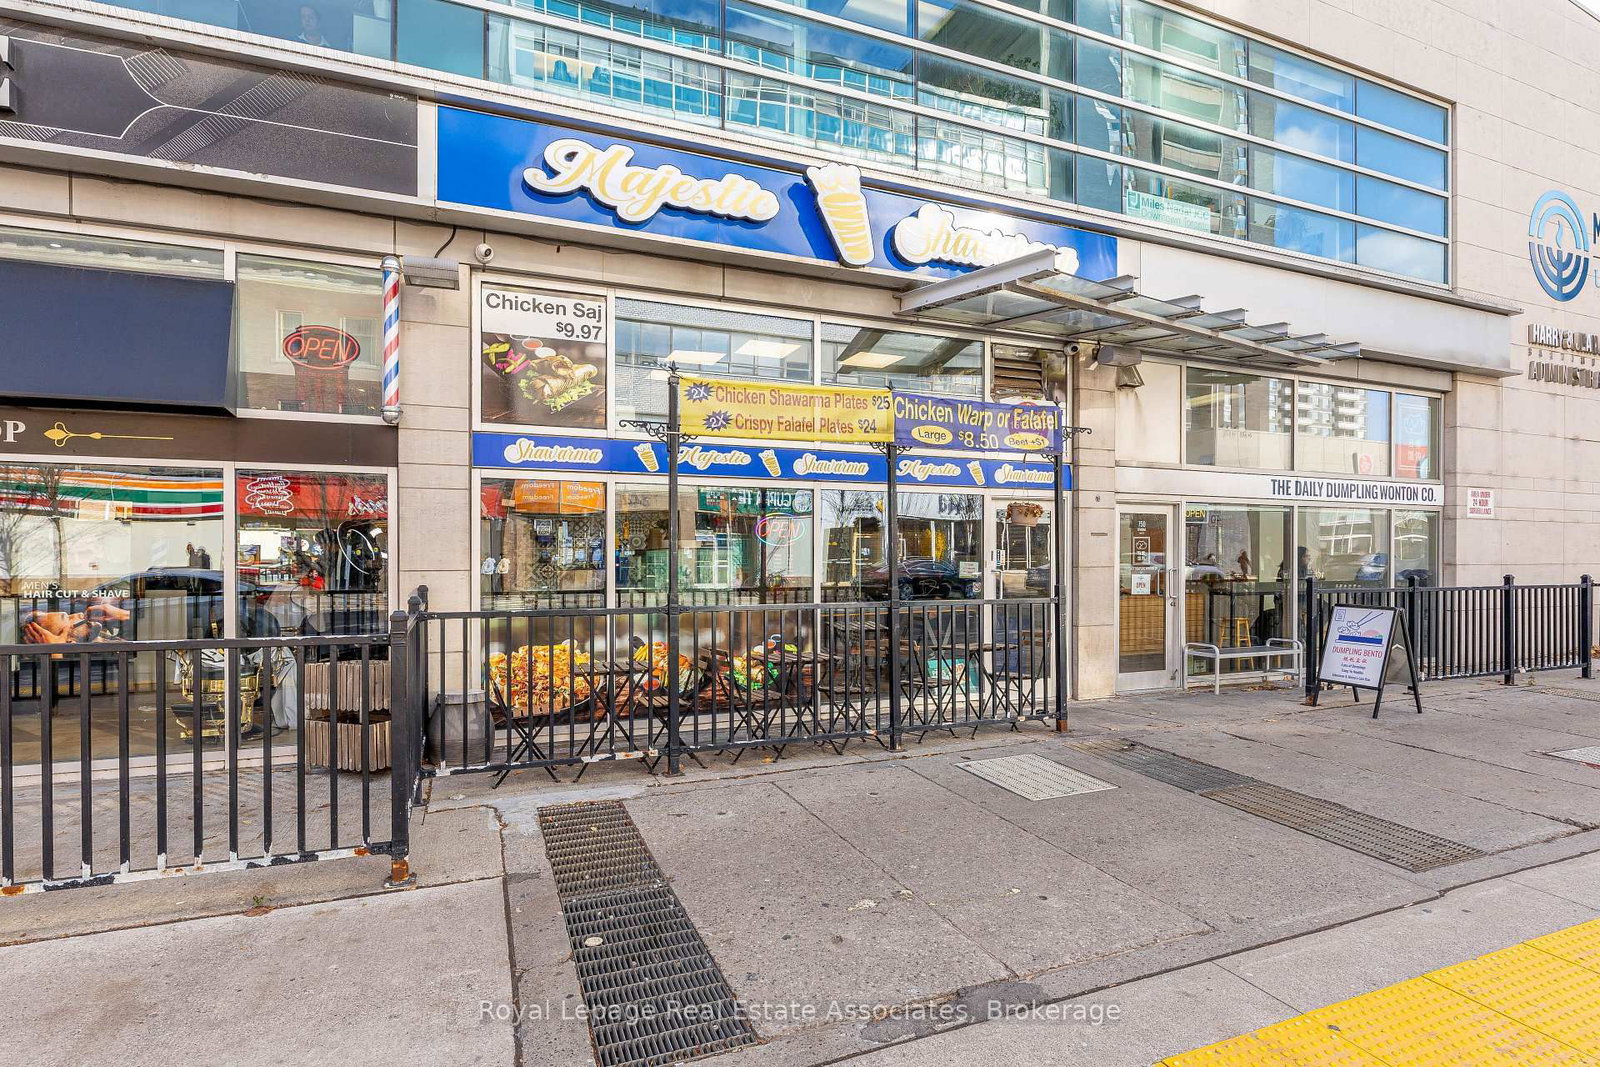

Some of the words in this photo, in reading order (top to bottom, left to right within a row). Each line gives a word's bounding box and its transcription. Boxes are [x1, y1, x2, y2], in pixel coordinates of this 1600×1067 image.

[523, 139, 780, 224] Majestic
[1141, 196, 1165, 210] Miles
[485, 292, 567, 316] Chicken
[572, 302, 602, 323] Saj
[556, 321, 602, 340] $9.97
[287, 336, 351, 361] OPEN
[691, 387, 707, 400] 2X
[715, 386, 766, 405] Chicken
[769, 388, 831, 409] Shawarma
[834, 393, 868, 410] Plates
[872, 394, 891, 411] $25
[708, 415, 727, 428] 2X
[735, 413, 774, 435] Crispy
[777, 415, 815, 433] Falafel
[819, 418, 854, 434] Plates
[858, 418, 877, 434] $24
[894, 396, 953, 423] Chicken
[957, 403, 993, 431] Warp
[997, 412, 1011, 427] or
[1013, 409, 1059, 430] Falafel
[0, 419, 26, 443] P
[918, 427, 947, 442] Large
[958, 430, 999, 449] $8.50
[504, 438, 603, 464] Shawarma
[672, 446, 752, 470] Majestic
[793, 453, 870, 476] Shawarma
[896, 459, 962, 481] Majestic
[994, 463, 1054, 484] Shawarma
[1271, 478, 1291, 495] THE
[1295, 479, 1324, 498] DAILY
[1326, 482, 1378, 500] DUMPLING
[1380, 485, 1419, 502] WONTON
[1421, 487, 1437, 502] CO.
[1184, 509, 1207, 518] OPEN
[758, 520, 801, 538] OPEN
[22, 580, 58, 591] MEN'S
[23, 589, 53, 600] HAIR
[55, 589, 79, 599] CUT
[81, 590, 90, 599] &
[92, 588, 130, 599] SHAVE
[1331, 645, 1363, 656] DUMPLING
[1363, 650, 1383, 658] BENTO
